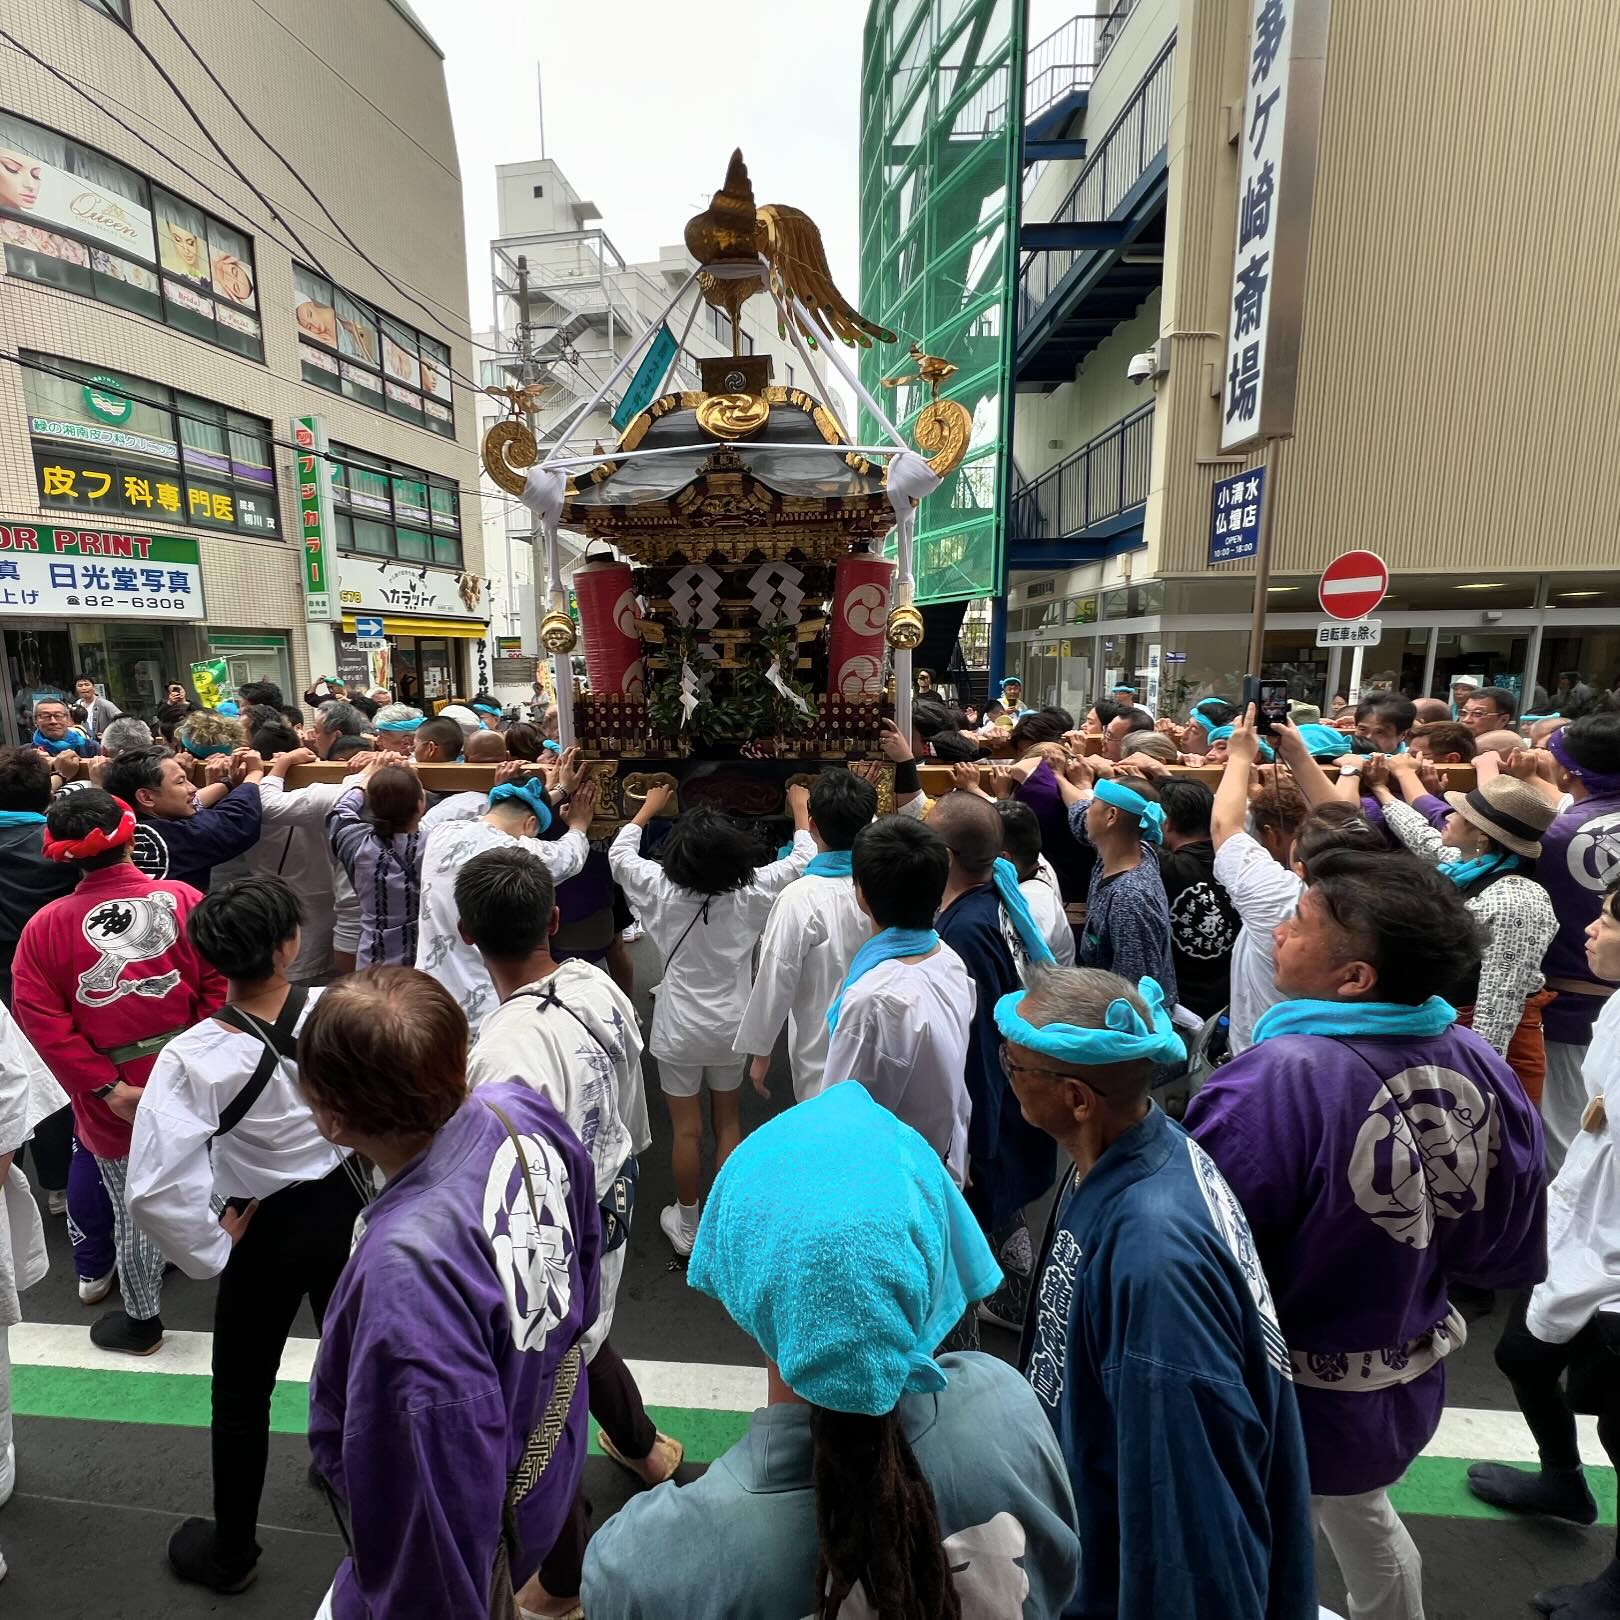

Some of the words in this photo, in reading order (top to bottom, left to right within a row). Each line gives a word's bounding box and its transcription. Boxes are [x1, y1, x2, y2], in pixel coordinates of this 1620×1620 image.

[69, 192, 138, 238] Queen
[1217, 476, 1260, 509] 小清水
[299, 456, 321, 582] フジカラー
[1215, 504, 1257, 535] 仏壇店
[53, 529, 153, 560] PRINT
[1225, 534, 1243, 546] OPEN
[49, 562, 192, 595] 日光堂写真
[85, 594, 186, 610] 82-6308
[1319, 626, 1377, 642] 自転車を除く
